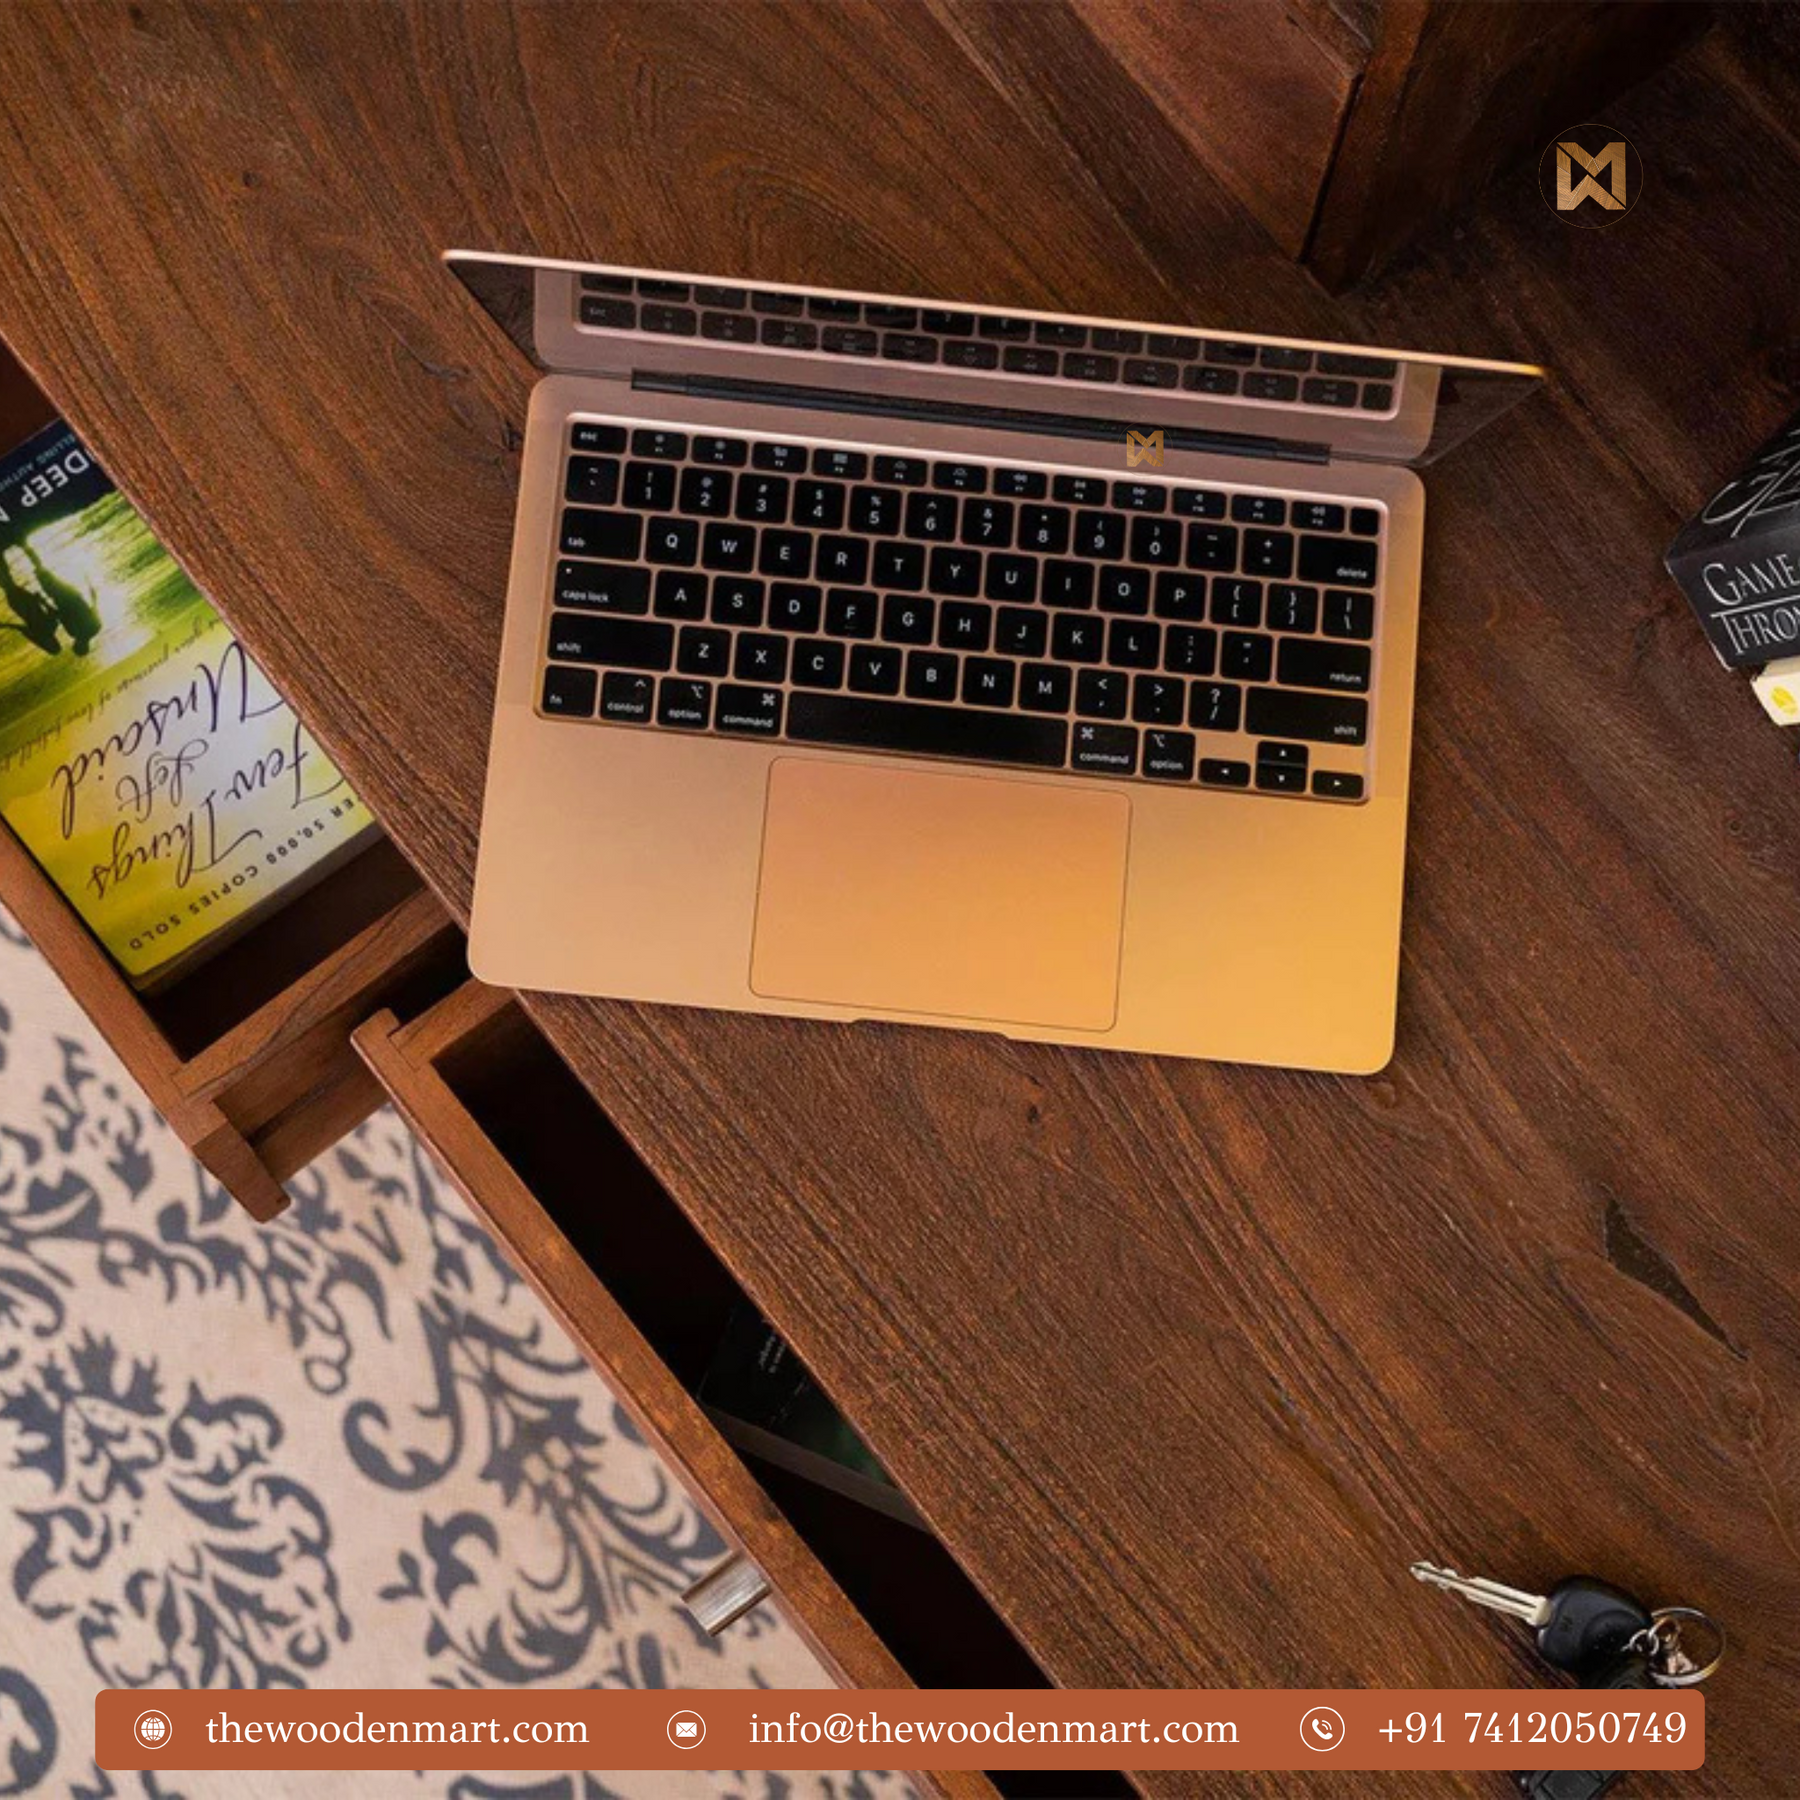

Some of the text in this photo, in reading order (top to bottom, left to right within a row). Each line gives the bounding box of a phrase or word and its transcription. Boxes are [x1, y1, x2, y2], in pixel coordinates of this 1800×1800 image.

[20, 446, 96, 507] DEEP
[700, 491, 711, 507] 2
[757, 498, 767, 512] 3
[812, 505, 823, 518] 4
[869, 510, 880, 525] 5
[925, 516, 936, 531] 6
[983, 522, 993, 536] 7
[568, 537, 586, 547] tab
[665, 533, 679, 549] Q
[1037, 529, 1049, 543] 8
[1094, 534, 1105, 549] 9
[721, 539, 738, 553] W
[779, 546, 790, 560] E
[836, 551, 848, 566] R
[894, 558, 904, 571] T
[950, 565, 961, 578] Y
[1005, 571, 1018, 585] U
[1336, 567, 1368, 579] delete
[1702, 553, 1800, 606] GAME
[561, 589, 609, 603] caps lock
[674, 588, 687, 601] A
[732, 593, 743, 608] S
[1174, 588, 1186, 601] P
[788, 599, 801, 614] D
[846, 605, 856, 619] F
[902, 611, 914, 627] G
[958, 618, 971, 632] H
[1017, 625, 1027, 639] J
[1072, 630, 1083, 644] K
[556, 642, 581, 653] shift
[698, 643, 710, 659] Z
[1128, 637, 1138, 651] L
[755, 649, 767, 664] X
[812, 655, 824, 671] C
[869, 662, 882, 676] V
[926, 667, 937, 683] B
[982, 673, 995, 688] N
[1329, 673, 1362, 683] return
[1038, 680, 1053, 694] M
[606, 702, 644, 714] control
[667, 708, 702, 721] option
[722, 713, 774, 728] command
[1333, 725, 1358, 736] shift
[51, 639, 286, 841] Unsaid
[1079, 751, 1130, 765] command
[1149, 759, 1185, 771] option
[115, 738, 210, 824] Left
[86, 788, 264, 900] Things
[188, 864, 259, 915] COPIES
[129, 913, 182, 951] SOLD
